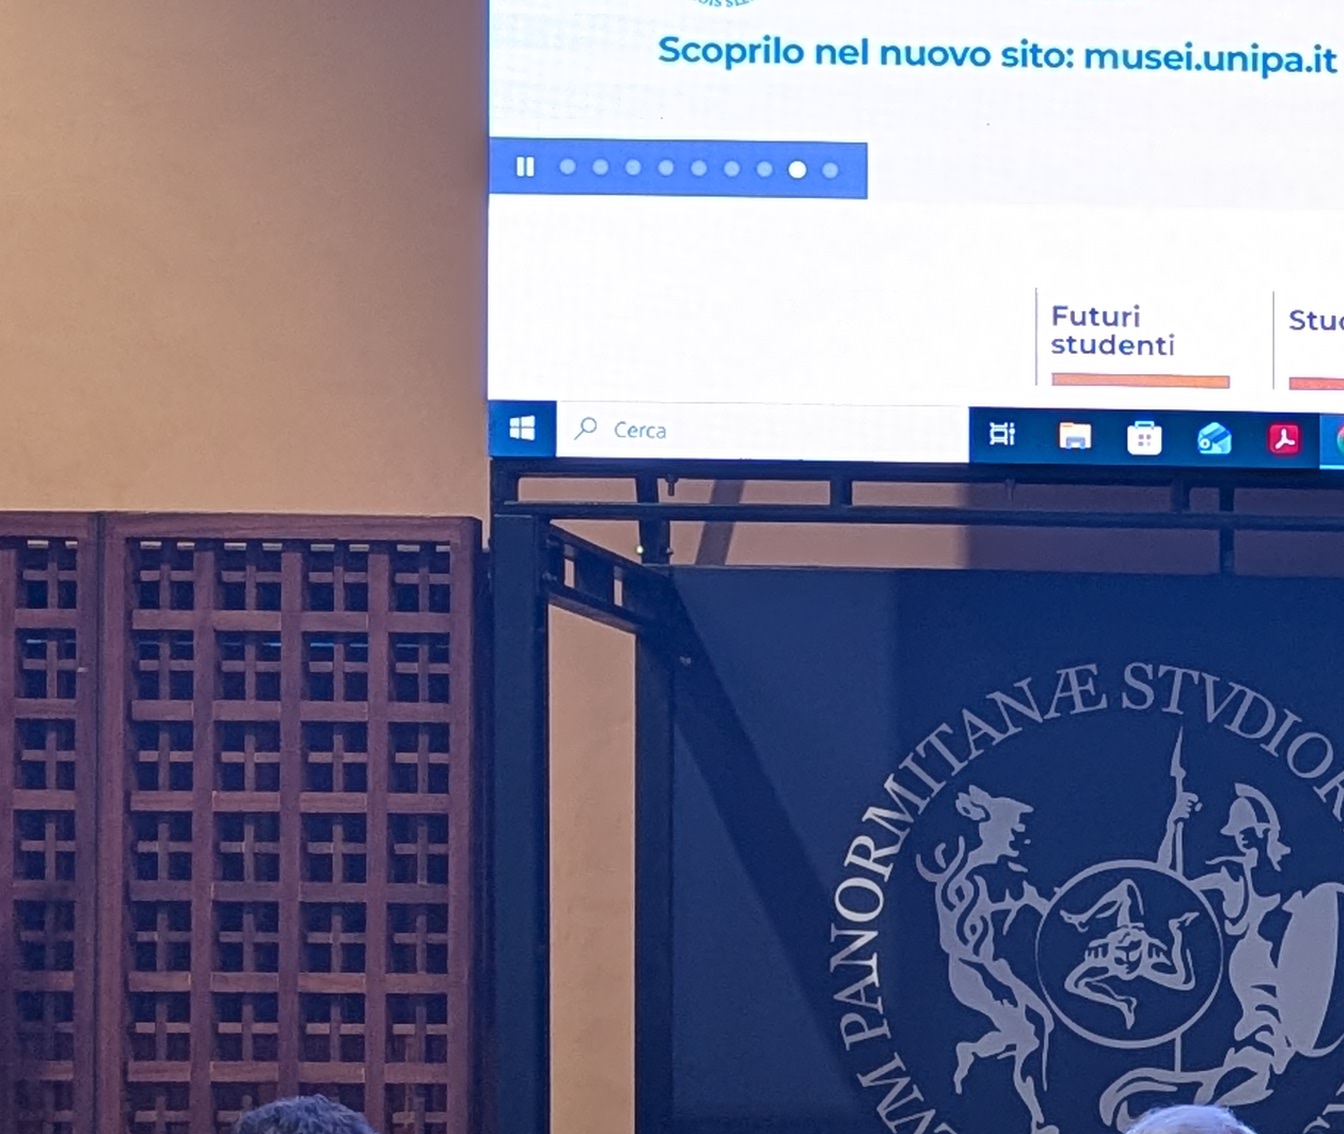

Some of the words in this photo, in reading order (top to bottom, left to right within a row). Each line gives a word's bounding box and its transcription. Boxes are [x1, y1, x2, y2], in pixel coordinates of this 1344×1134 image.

[658, 35, 805, 71] Scoprilo
[815, 37, 869, 66] nel
[880, 45, 992, 67] nuovo
[1001, 38, 1074, 69] sito:
[1085, 41, 1338, 80] musei.unipa.it
[1052, 304, 1140, 328] Futuri
[1050, 333, 1176, 357] studenti
[613, 420, 667, 440] Cerca
